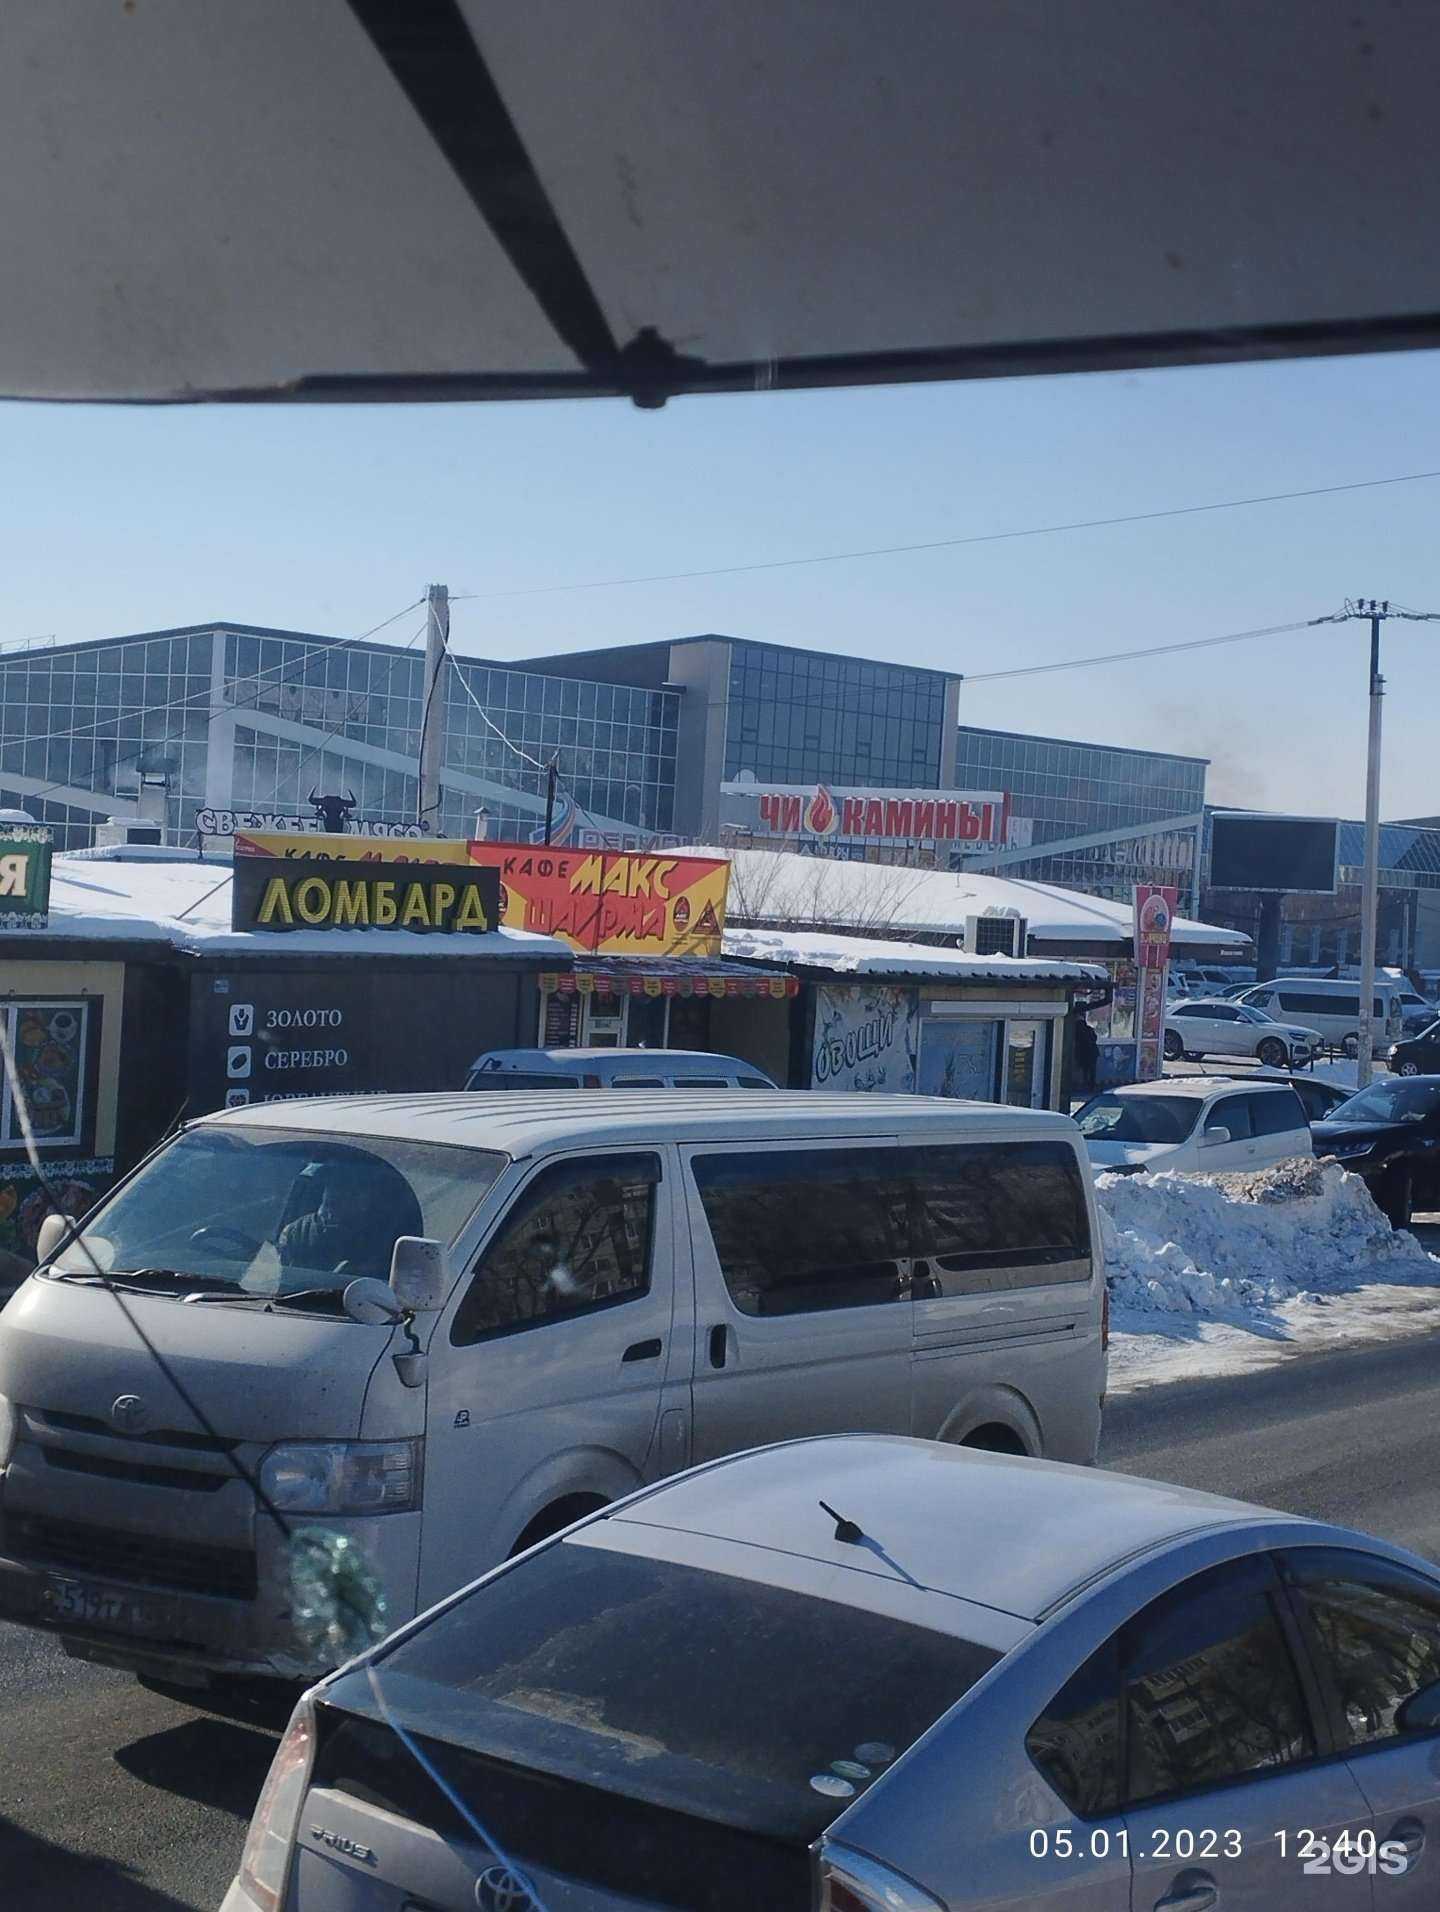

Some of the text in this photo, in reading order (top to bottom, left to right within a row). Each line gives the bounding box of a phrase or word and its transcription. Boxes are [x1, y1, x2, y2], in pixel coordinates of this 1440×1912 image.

[842, 797, 993, 841] КАМИНЫ
[503, 854, 679, 900] КАФЕ МАКС
[257, 876, 488, 932] ЛОМБАРД
[526, 895, 667, 941] ШАУРМА
[266, 1009, 343, 1028] ЗОЛОТО
[264, 1049, 348, 1070] СЕРЕБРО
